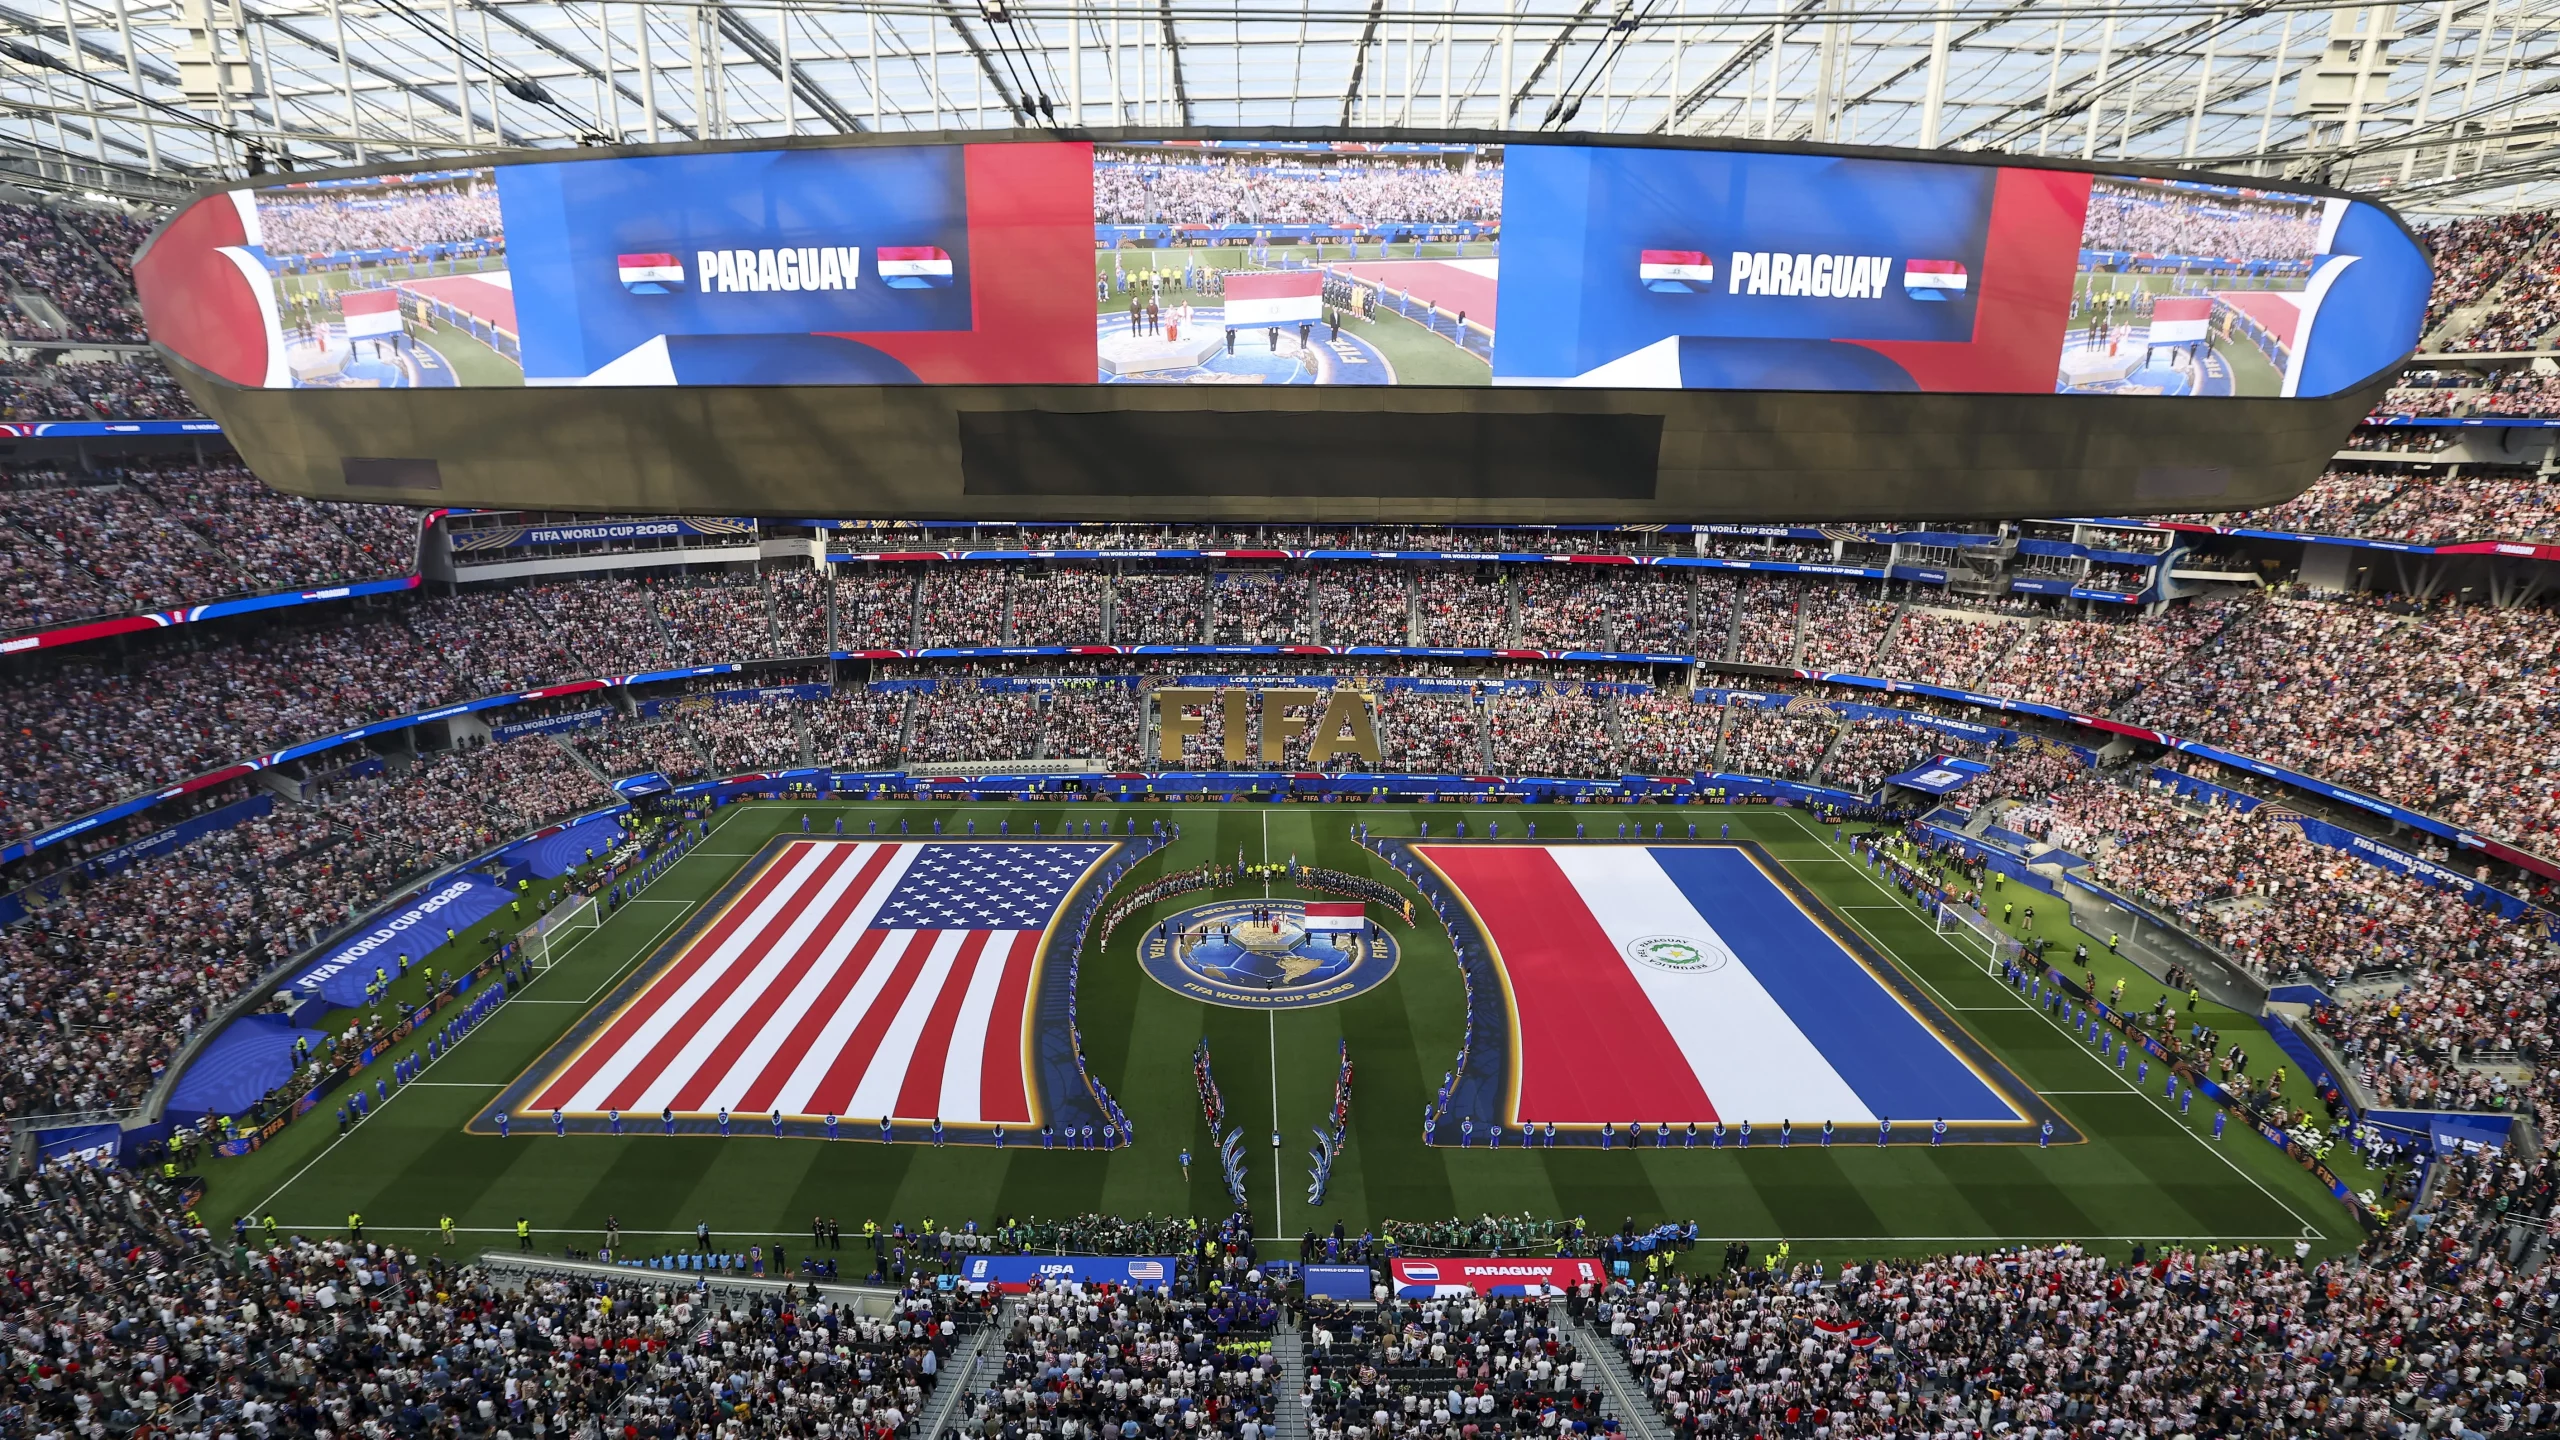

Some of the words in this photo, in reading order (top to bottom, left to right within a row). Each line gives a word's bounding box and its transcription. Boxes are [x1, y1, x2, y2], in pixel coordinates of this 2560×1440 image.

[697, 247, 860, 293] PARAGUAY
[1728, 251, 1893, 299] PARAGUAY
[531, 530, 561, 542] FIFA
[561, 527, 608, 540] WORLD
[609, 526, 634, 537] CUP
[635, 524, 678, 536] 2026
[1691, 525, 1709, 533] FIFA
[1710, 525, 1739, 534] WORLD
[1740, 526, 1758, 535] CUP
[1758, 527, 1789, 536] 2026
[504, 725, 524, 735] FIFA
[524, 718, 555, 730] WORLD
[556, 715, 571, 725] CUP
[573, 709, 602, 722] 2026
[1160, 687, 1382, 761] FIFA
[1911, 713, 1933, 724] LOS
[1934, 718, 1987, 733] ANGELES
[2353, 836, 2375, 852] FIFA
[2376, 845, 2412, 867] WORLD
[615, 863, 627, 875] FIFA
[587, 882, 600, 894] FIFA
[296, 963, 345, 988] FIFA
[331, 929, 396, 964] WORLD
[388, 910, 423, 931] CUP
[417, 881, 473, 914] 2026
[1640, 938, 1689, 948] PARAGUAY
[1149, 938, 1168, 959] FIFA
[1183, 982, 1213, 995] FIFA
[1216, 991, 1272, 1002] WORLD
[1274, 994, 1304, 1003] CUP
[1306, 982, 1355, 999] 2026
[414, 1007, 431, 1023] FIFA
[2105, 1010, 2123, 1029] FIFA
[371, 1039, 390, 1056] FIFA
[2150, 1043, 2168, 1061] FIFA
[262, 1117, 285, 1139] FIFA
[2258, 1121, 2281, 1145] FIFA
[2315, 1165, 2335, 1190] FIFA
[1039, 1264, 1074, 1274] USA
[1464, 1266, 1553, 1276] PARAGUAY
